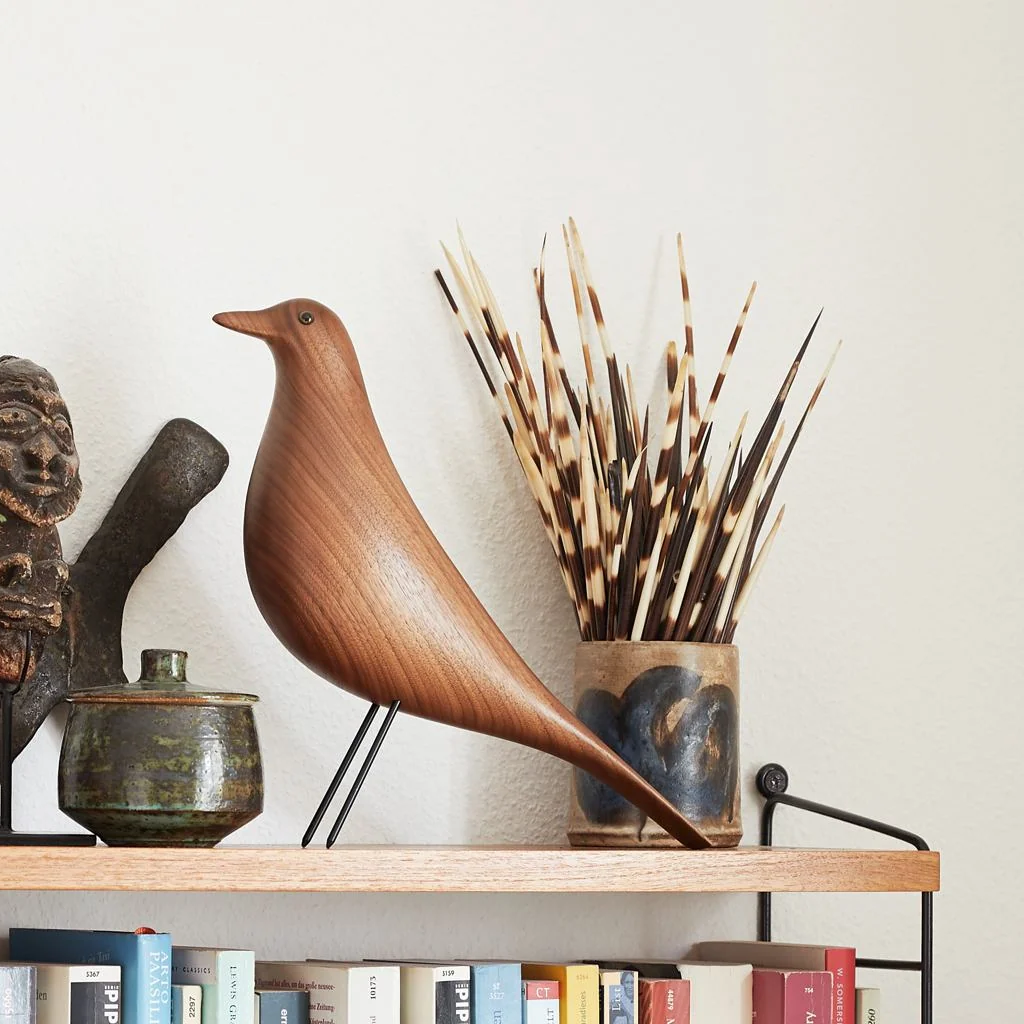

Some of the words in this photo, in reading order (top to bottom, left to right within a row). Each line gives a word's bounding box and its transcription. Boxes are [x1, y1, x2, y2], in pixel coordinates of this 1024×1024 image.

[160, 951, 169, 1004] ARTO
[229, 966, 237, 1000] LEWIS
[536, 987, 551, 998] CT
[612, 988, 622, 1011] List
